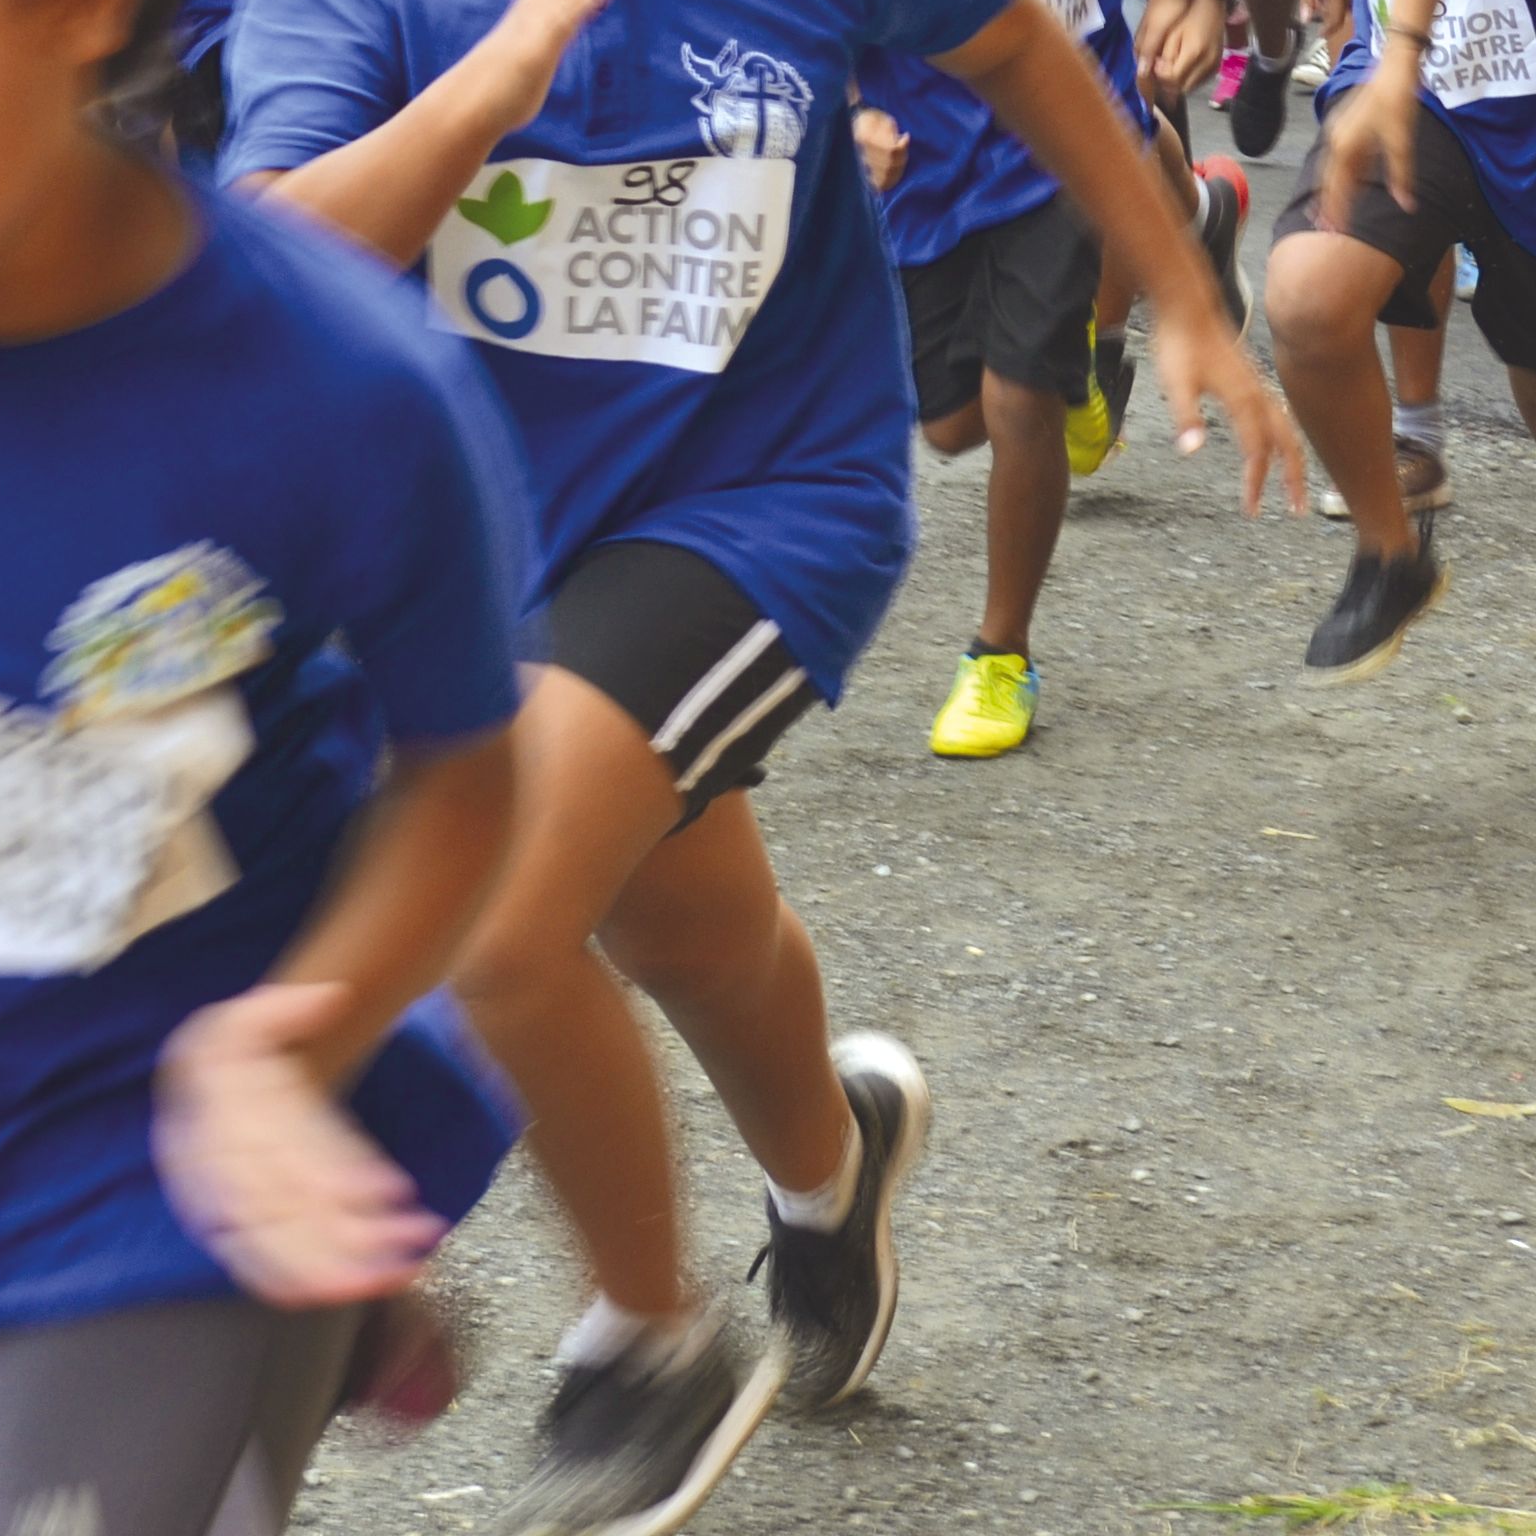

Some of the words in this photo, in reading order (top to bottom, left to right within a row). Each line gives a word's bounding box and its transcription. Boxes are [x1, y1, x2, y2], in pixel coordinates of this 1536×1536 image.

[1429, 7, 1518, 41] CTION
[1424, 32, 1524, 69] ONTRE
[1454, 57, 1531, 90] FAIM
[569, 206, 764, 252] ACTION
[568, 250, 763, 299] CONTRE
[568, 296, 623, 335] LA
[641, 296, 756, 347] FAIM
